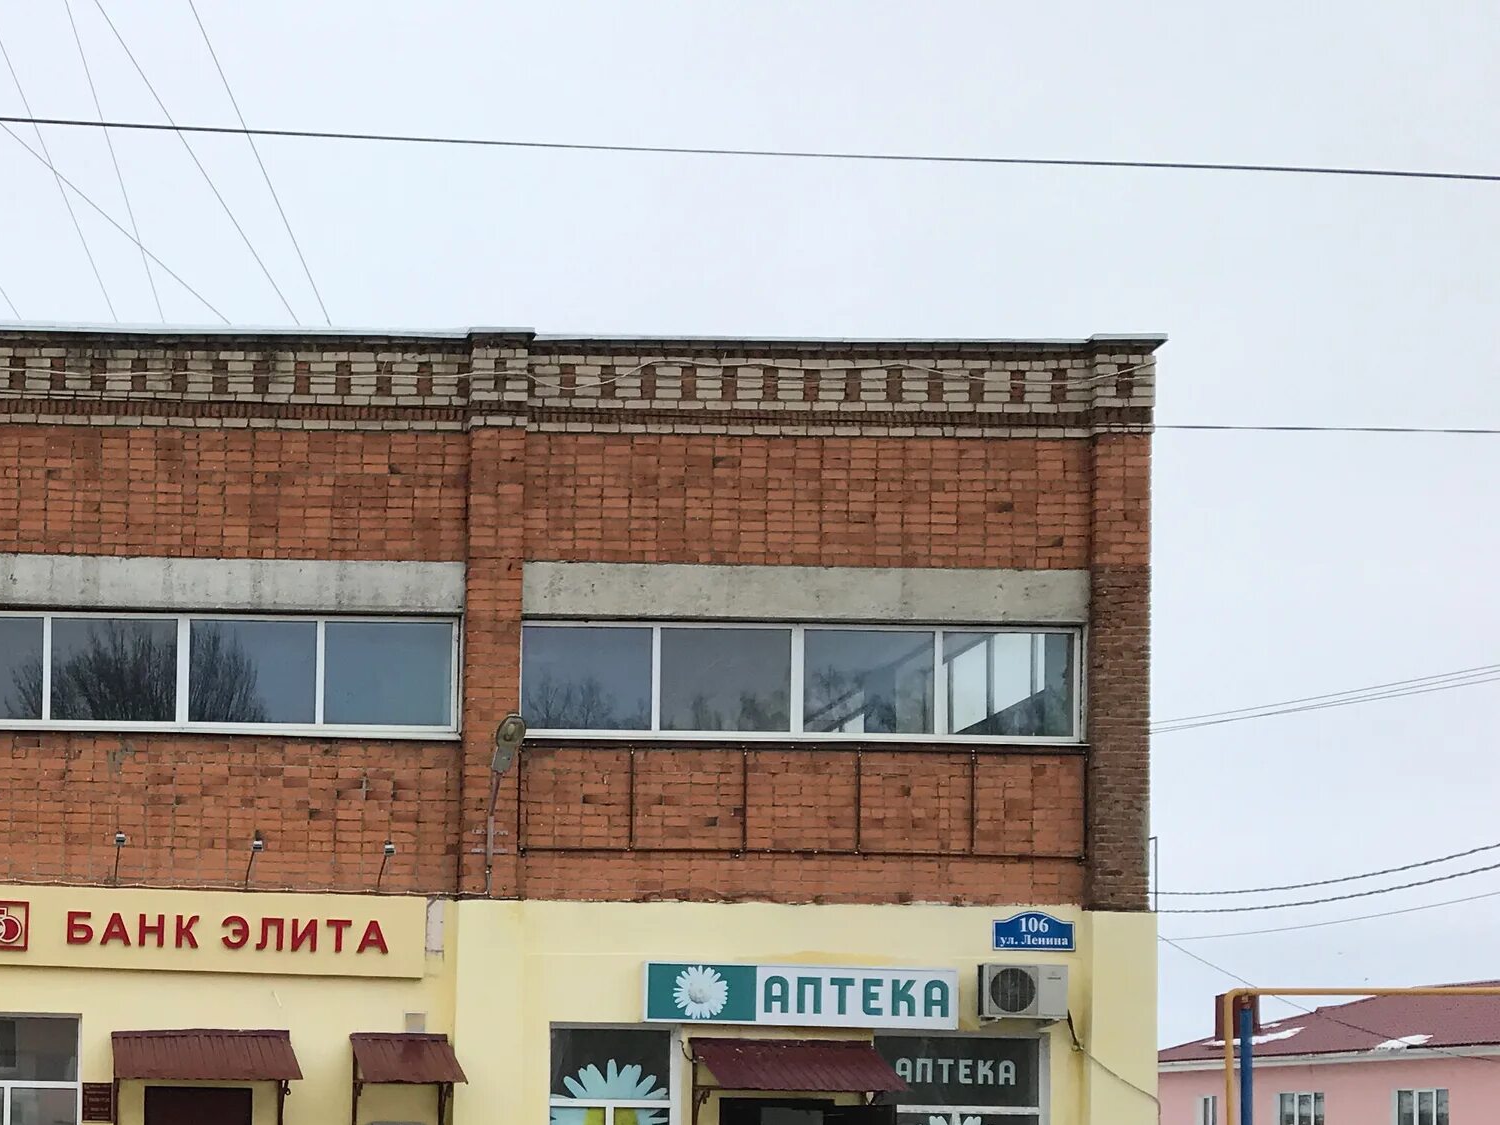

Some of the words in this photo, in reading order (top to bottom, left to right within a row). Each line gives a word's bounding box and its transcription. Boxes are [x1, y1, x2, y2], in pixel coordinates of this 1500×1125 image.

[66, 911, 200, 949] БАНК
[221, 915, 389, 954] ЭЛИТА
[1020, 917, 1049, 933] 106
[1000, 936, 1018, 947] ул.
[1021, 934, 1069, 946] Ленина
[764, 975, 949, 1017] АПТЕКА
[895, 1057, 1016, 1086] АПТЕКА
